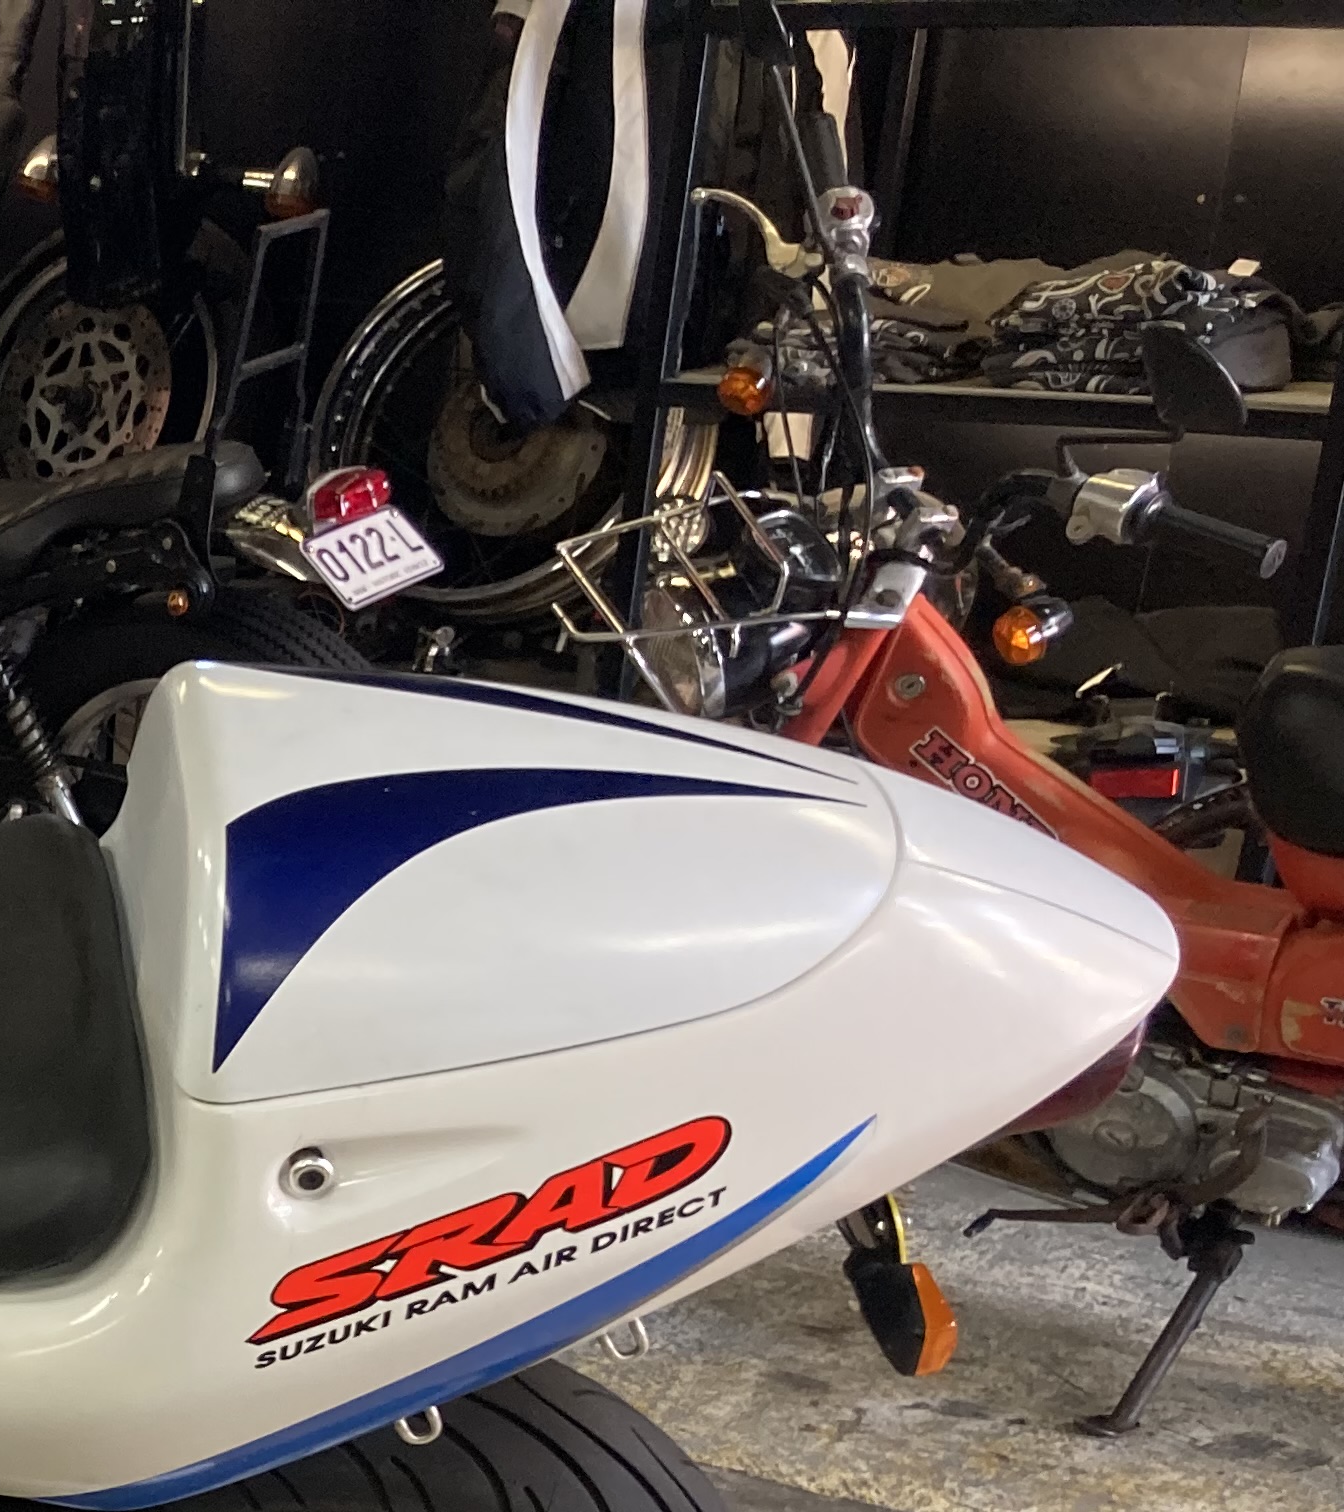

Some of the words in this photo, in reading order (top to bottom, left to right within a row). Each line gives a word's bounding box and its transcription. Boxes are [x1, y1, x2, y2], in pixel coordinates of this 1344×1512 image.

[245, 1115, 733, 1345] SRAD
[254, 1309, 391, 1369] SUZUKI
[404, 1273, 496, 1320] RAM
[507, 1246, 577, 1285] AIR
[590, 1186, 727, 1254] DIRECT
